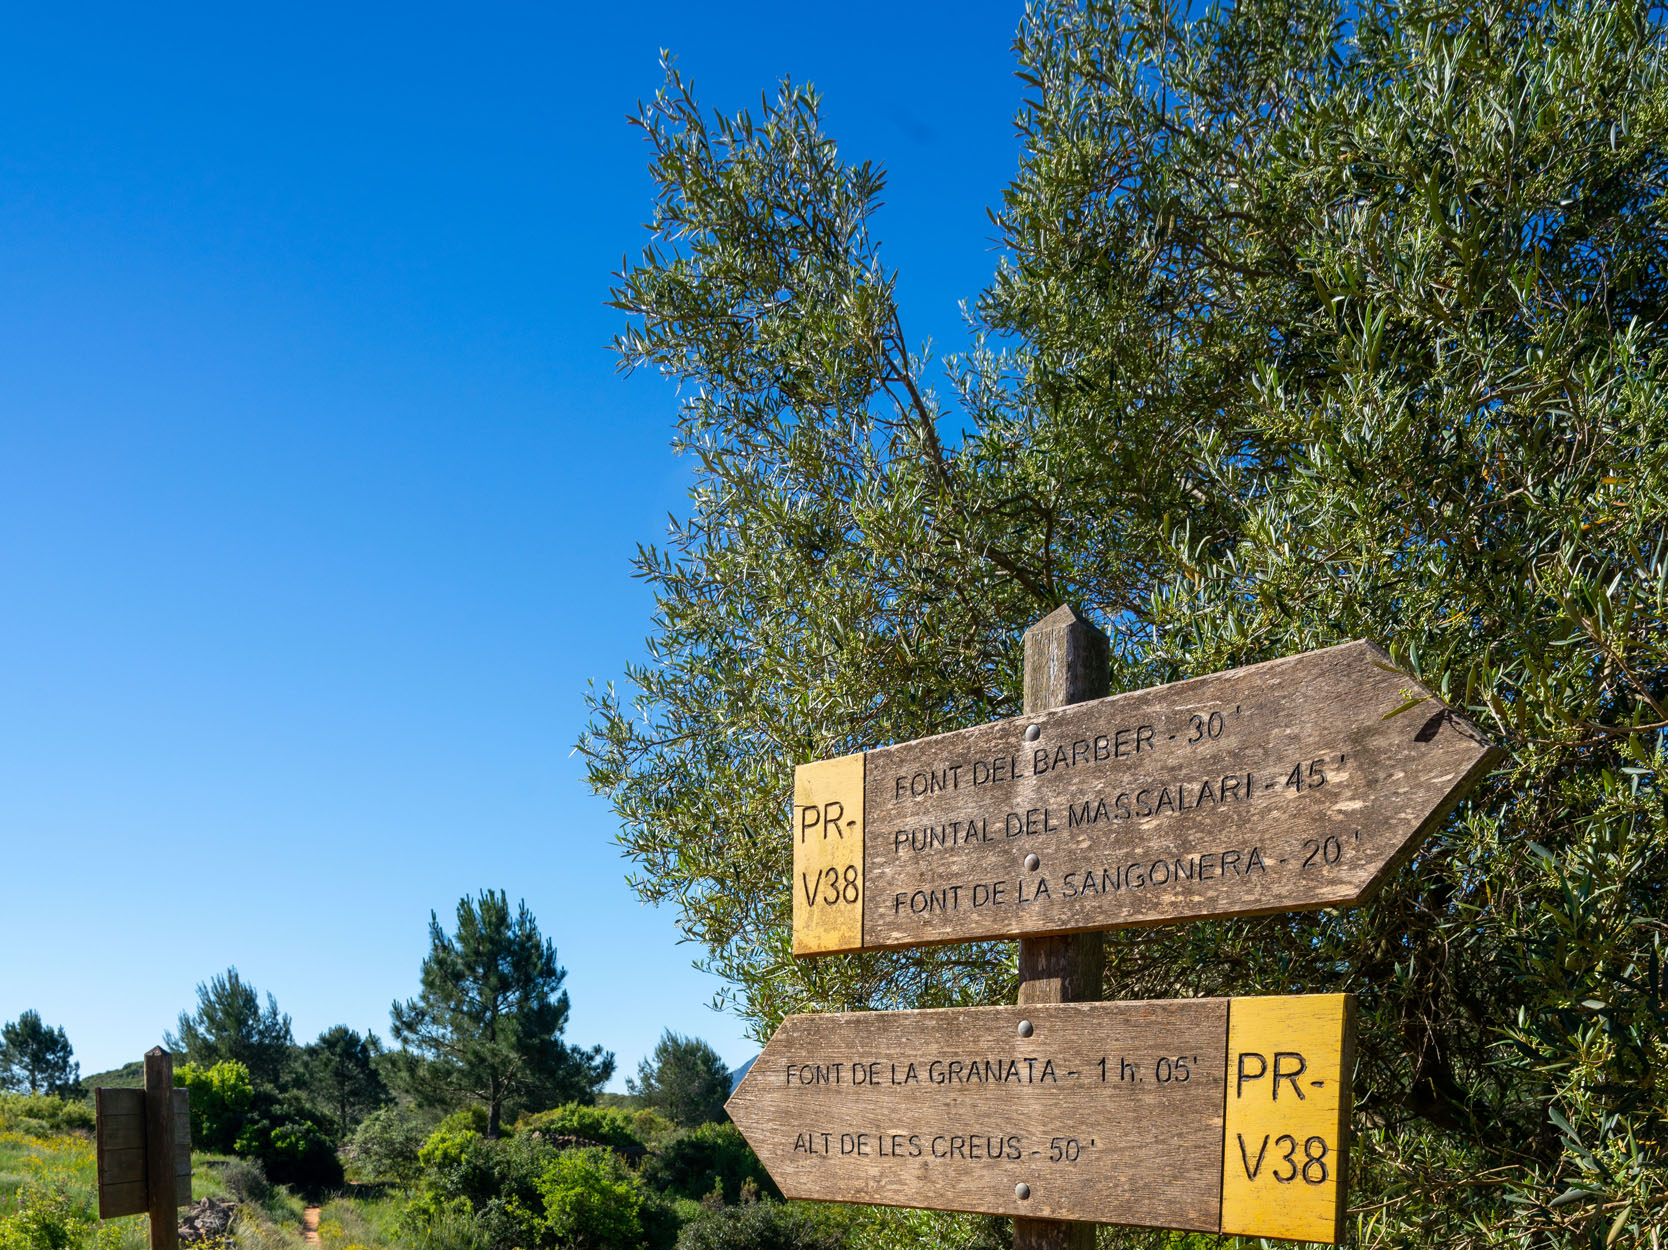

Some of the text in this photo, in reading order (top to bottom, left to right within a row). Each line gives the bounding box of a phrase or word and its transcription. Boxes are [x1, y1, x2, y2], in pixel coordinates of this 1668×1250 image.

[895, 764, 963, 800] FONT
[973, 756, 1023, 786] DEL
[1033, 725, 1156, 776] BARBER
[801, 801, 856, 844] PR-
[895, 817, 994, 853] PUNTAL
[1006, 808, 1056, 840] DEL
[1068, 772, 1253, 828] MASSALARI
[802, 864, 859, 907] V38
[894, 885, 962, 914] FONT
[973, 881, 1006, 907] DE
[1018, 877, 1051, 904] LA
[1063, 847, 1266, 899] SANGONERA
[786, 1063, 844, 1086] FONT
[852, 1062, 881, 1086] DE
[891, 1062, 919, 1085] LA
[929, 1058, 1057, 1085] GRANATA
[1098, 1058, 1106, 1082] 1
[1237, 1052, 1325, 1102] PR-
[793, 1133, 833, 1154] ALT
[841, 1133, 868, 1156] DE
[879, 1134, 922, 1158] LES
[931, 1135, 1023, 1161] CREUS
[1237, 1133, 1330, 1185] V38
